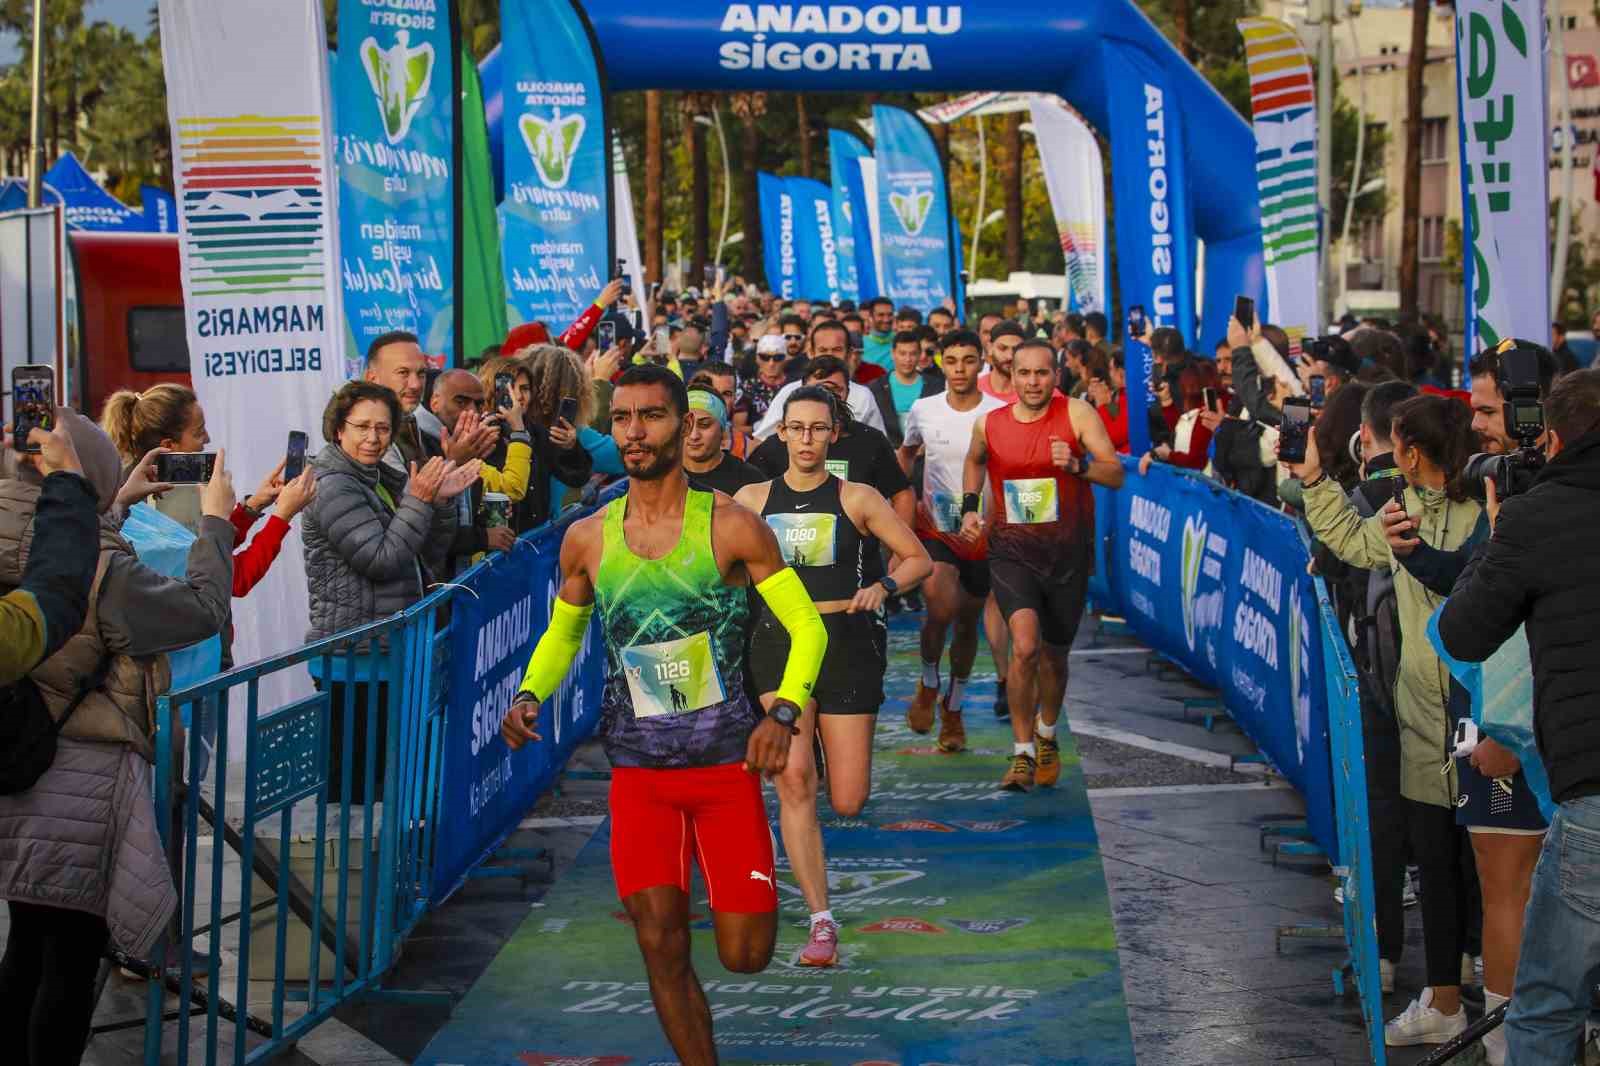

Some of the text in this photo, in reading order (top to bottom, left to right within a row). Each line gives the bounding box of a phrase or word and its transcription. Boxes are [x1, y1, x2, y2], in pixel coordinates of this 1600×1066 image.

[720, 4, 962, 35] ANADOLU
[719, 33, 932, 71] SİGORTA
[785, 527, 817, 542] 1080
[474, 594, 531, 683] ANADOLU
[654, 659, 691, 681] 1126
